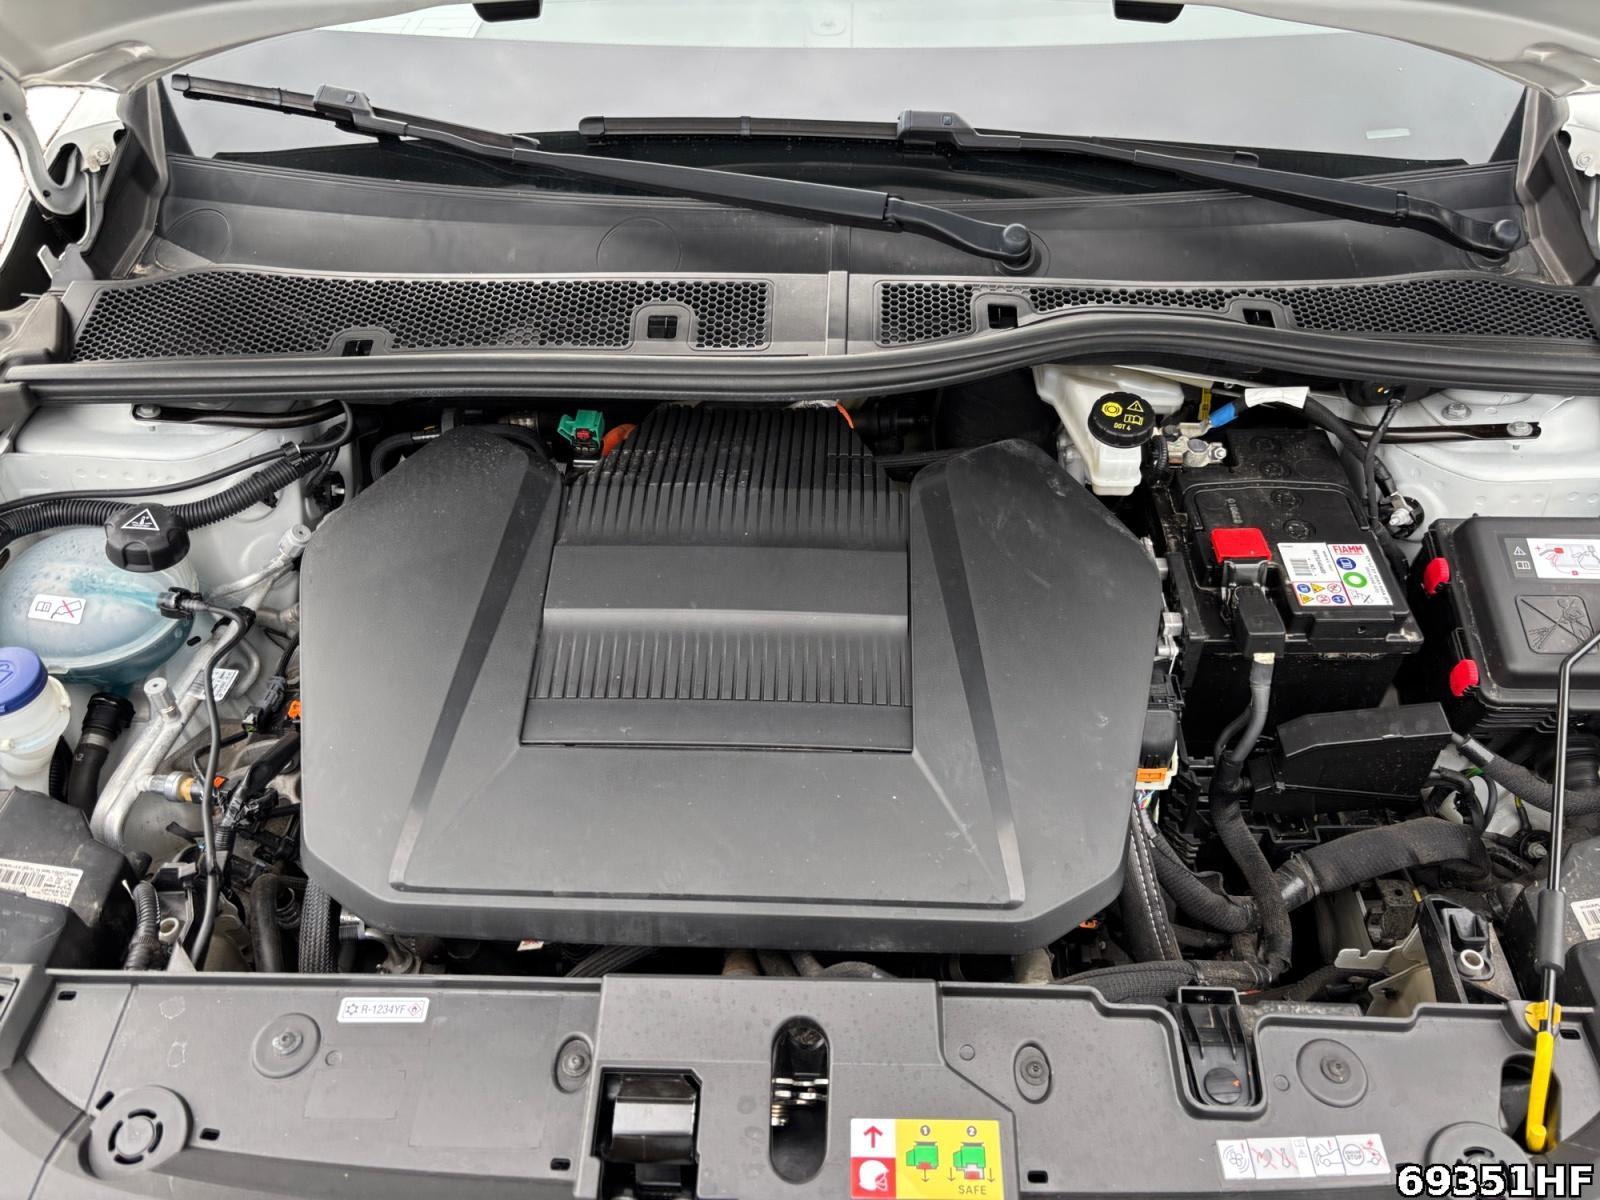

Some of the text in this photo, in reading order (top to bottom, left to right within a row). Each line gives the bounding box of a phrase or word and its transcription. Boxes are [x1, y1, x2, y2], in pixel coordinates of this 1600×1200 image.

[1332, 545, 1364, 554] FIAMM
[361, 1004, 406, 1015] R-1234YF
[958, 1185, 987, 1195] SAFE
